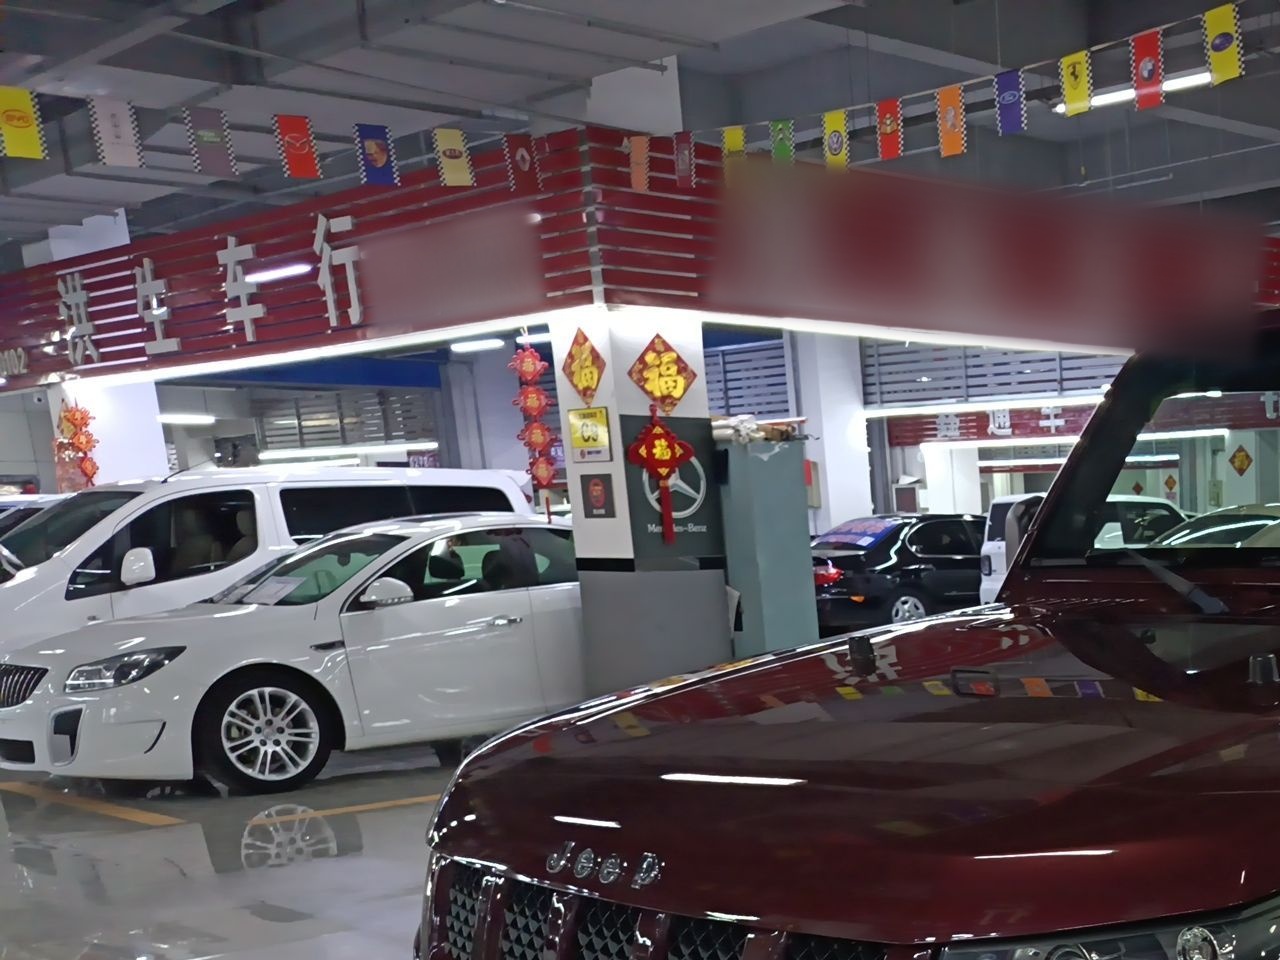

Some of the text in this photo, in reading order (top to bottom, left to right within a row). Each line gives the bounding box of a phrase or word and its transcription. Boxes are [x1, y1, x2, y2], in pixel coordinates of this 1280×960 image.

[643, 350, 686, 399] 福
[652, 438, 672, 461] 福
[546, 841, 660, 889] Jeep
